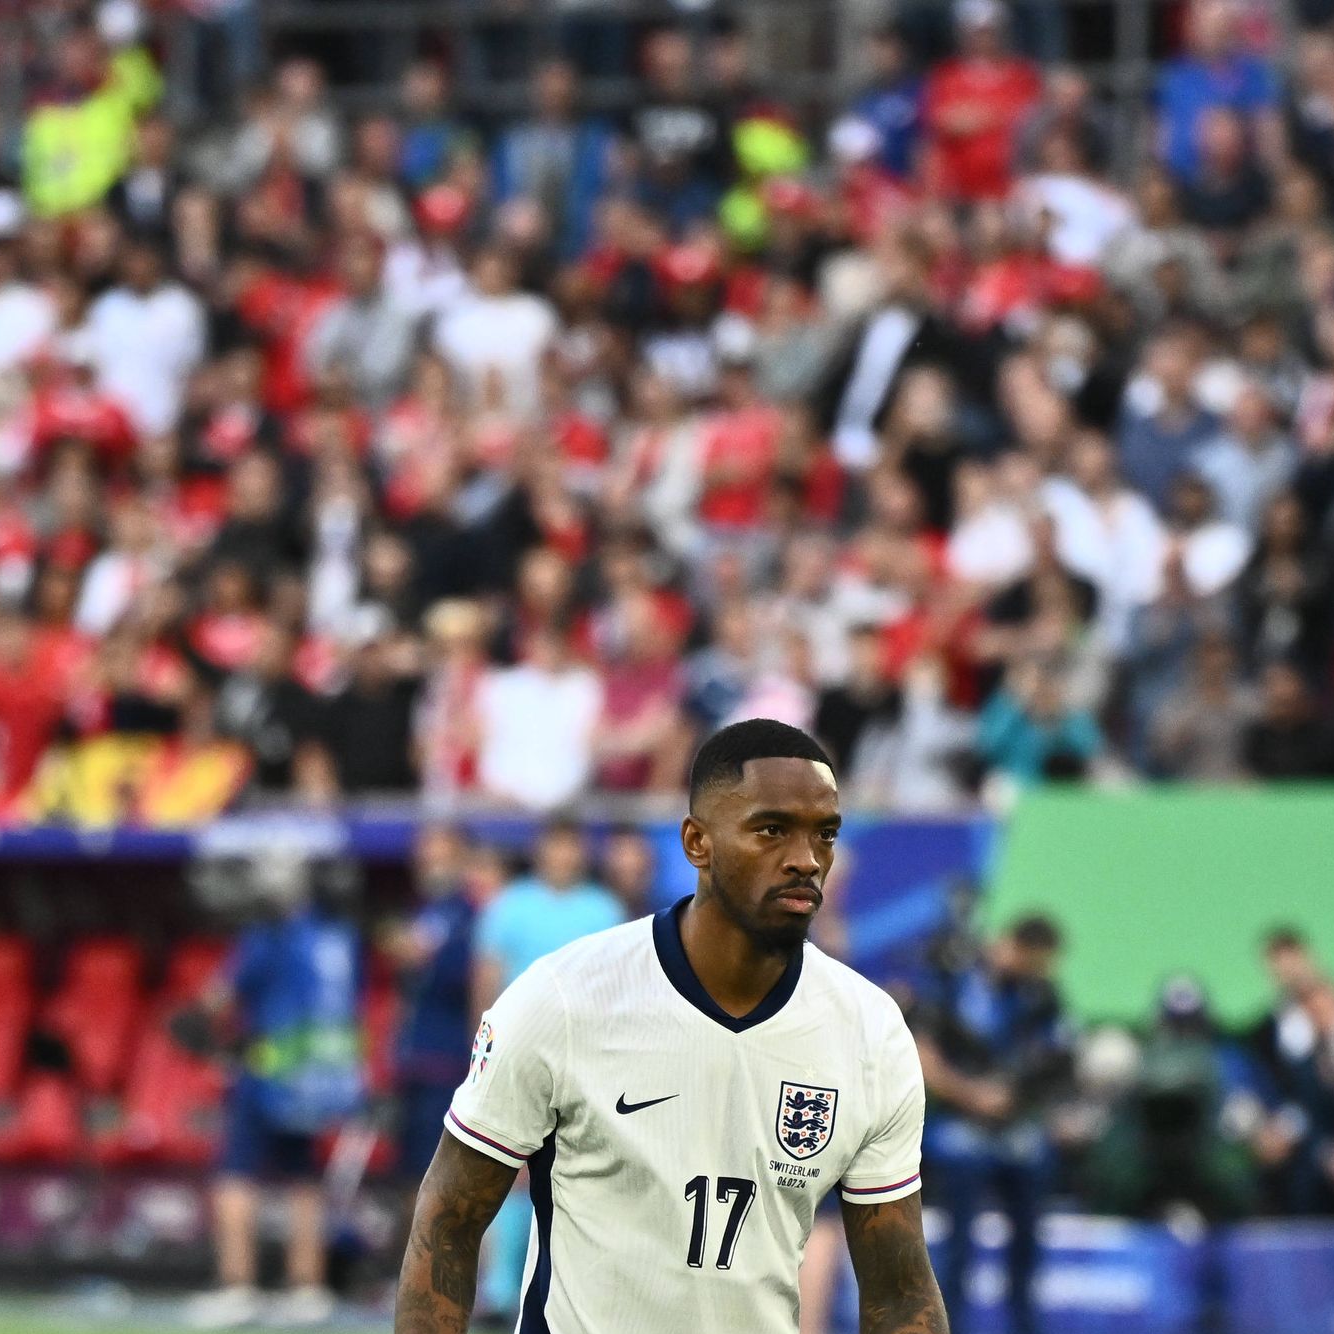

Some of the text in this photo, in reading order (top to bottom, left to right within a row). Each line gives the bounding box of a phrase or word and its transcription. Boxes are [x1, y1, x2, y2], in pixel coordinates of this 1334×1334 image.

[769, 1160, 821, 1178] SWITZERLAND
[777, 1176, 807, 1189] 06.07.24
[684, 1175, 757, 1270] 17
